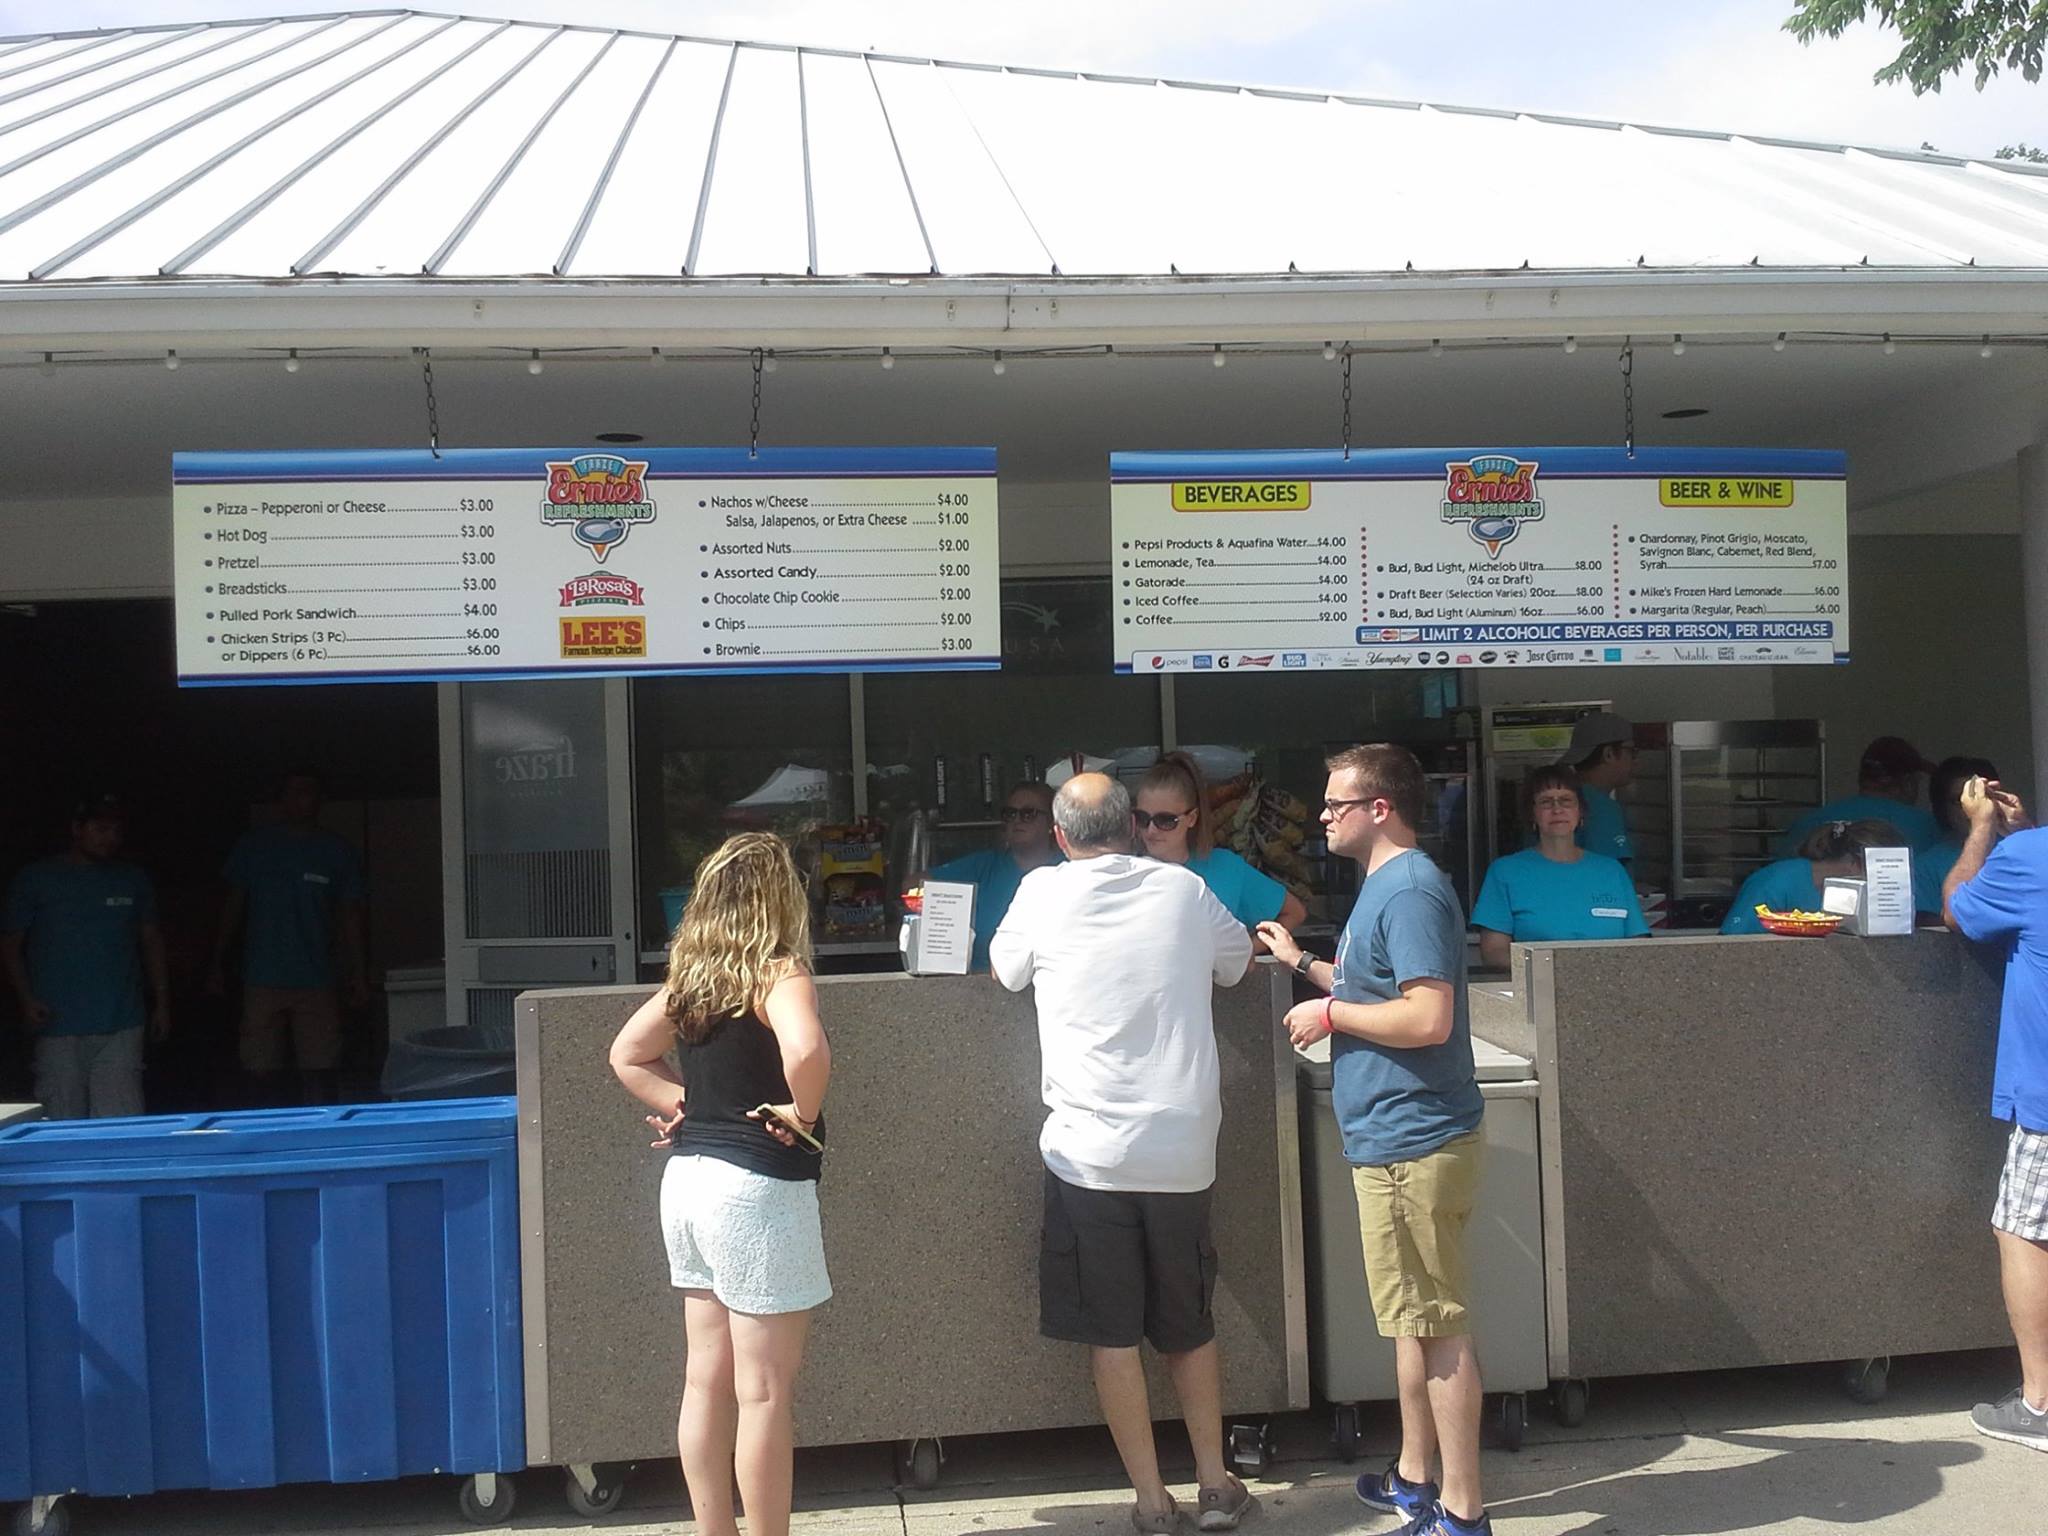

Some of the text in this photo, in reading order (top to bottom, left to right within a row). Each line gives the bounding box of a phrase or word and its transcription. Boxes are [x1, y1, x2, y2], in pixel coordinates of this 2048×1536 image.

[549, 469, 643, 504] Ernie's
[1448, 468, 1534, 503] Ernie's
[1670, 482, 1783, 499] BEER & WINE
[711, 493, 969, 509] Nachos w/Cheese $4.00
[1185, 485, 1298, 503] BEVERAGES
[217, 503, 247, 515] Pizza
[262, 501, 323, 515] Pepperoni
[326, 503, 340, 513] or
[344, 501, 386, 514] Cheese
[460, 499, 493, 513] $3.00
[544, 503, 652, 520] REFRESHMENTS
[1443, 502, 1541, 518] REFRESHMENTS
[726, 512, 969, 529] Salsa, Jalapenos, or Extra Cheese $1.00
[218, 525, 495, 544] Hot Dog $3.00
[1640, 533, 1808, 545] Chardonnay, Pinot Grigio, Moscato,
[712, 539, 969, 555] Assorted Nuts $2.00
[1135, 536, 1346, 550] Pepsi Products & Aquafina Water $4.00
[1640, 547, 1684, 558] Savignon
[1687, 546, 1714, 558] Blanc,
[1766, 546, 1784, 556] Red
[218, 552, 495, 569] Pretzel $3.00
[1135, 554, 1346, 570] Lemonade, Tea $4.00
[1389, 561, 1602, 574] Bud, Bud Light, Michelob Ultra $8.00
[1640, 559, 1836, 572] Syrah $7.00
[715, 563, 970, 580] Assorted Candy $2.00
[219, 578, 496, 596] Breadsticks $3.00
[568, 578, 634, 598] LaRosa's
[1135, 574, 1347, 588] Gatorade $4.00
[1467, 575, 1484, 585] (24
[1503, 575, 1533, 585] Draft)
[714, 588, 971, 605] Chocolate Chip Cookie $2.00
[1136, 592, 1347, 606] Iced Coffee $4.00
[1389, 587, 1603, 599] Draft Beer (Selection Varies) 20oz $8.00
[1640, 585, 1840, 597] Mike's Frozen Hard Lemonade $6.00
[220, 603, 498, 622] Pulled Pork Sandwich $4.00
[1136, 611, 1347, 625] Coffee $2.00
[1390, 609, 1412, 620] Bud,
[1415, 608, 1434, 618] Bud
[1437, 608, 1463, 620] Light
[1520, 607, 1543, 616] 16oz
[1577, 606, 1604, 616] $6.00
[1641, 605, 1689, 617] Margarita
[1736, 604, 1767, 616] Peach)
[1815, 604, 1840, 615] $6.00
[715, 613, 972, 632] Chips $2.00
[221, 628, 499, 645] Chicken Strips (3 Pc) $6.00
[563, 621, 642, 646] LEE'S
[1422, 623, 1828, 641] LIMIT 2 ALCOHOLIC BEVERAGES PER PERSON, PER PURCHASE
[222, 644, 501, 662] or Dippers (6 Pc) $6.00
[716, 638, 972, 656] Brownie $3.00
[1366, 651, 1412, 666] Yuengling
